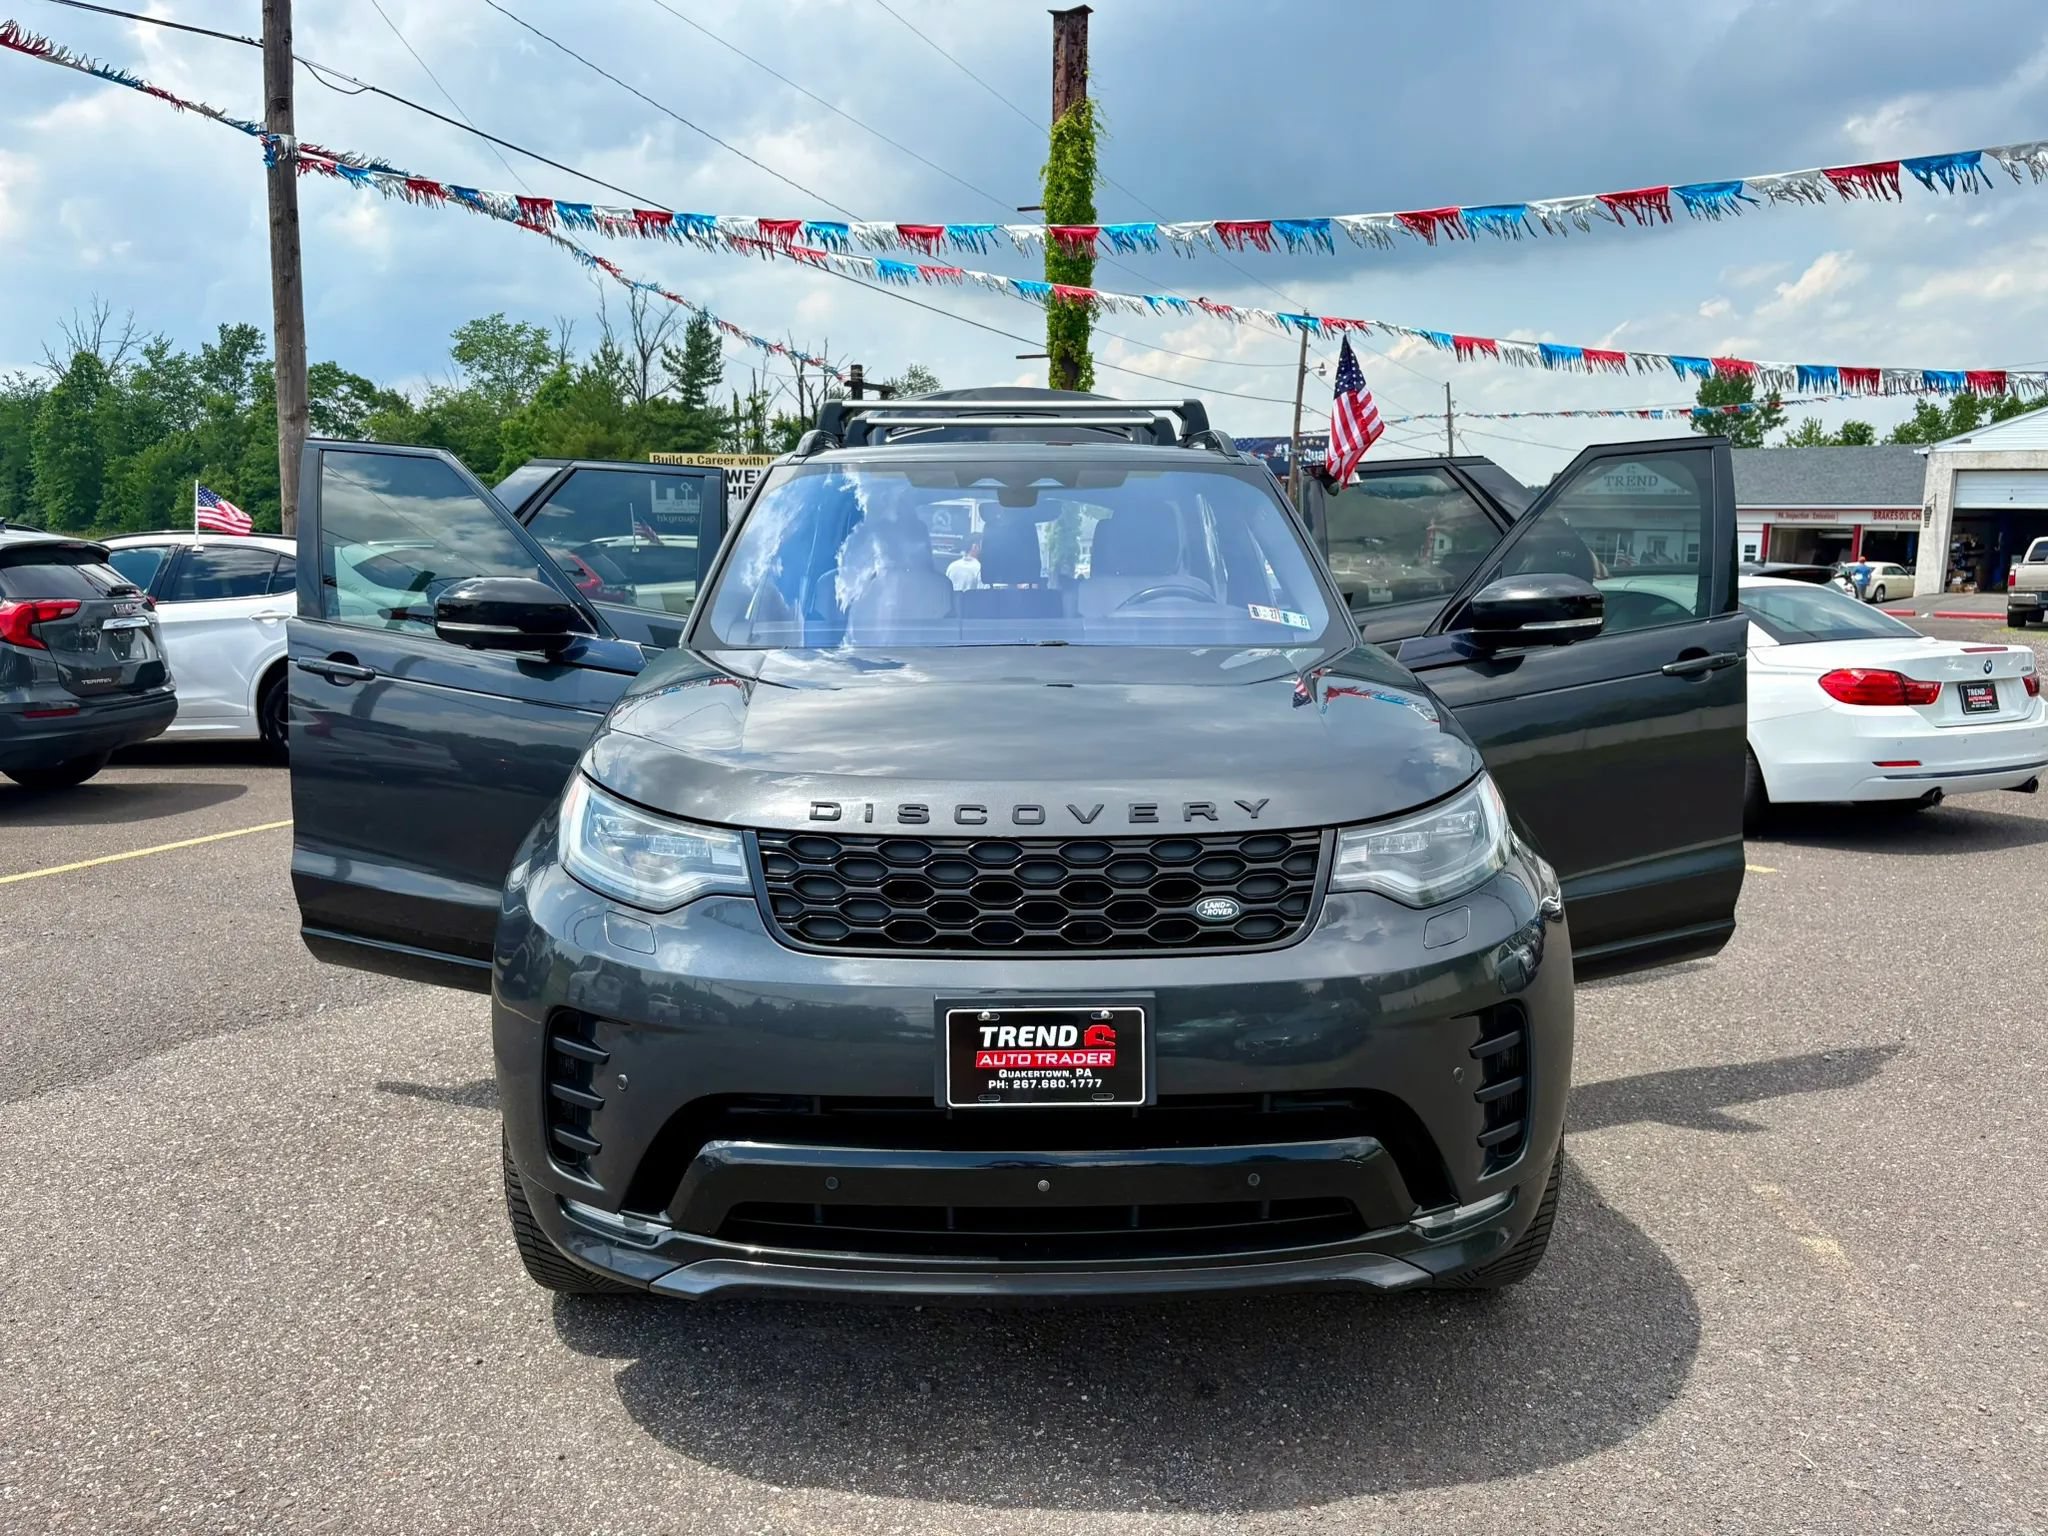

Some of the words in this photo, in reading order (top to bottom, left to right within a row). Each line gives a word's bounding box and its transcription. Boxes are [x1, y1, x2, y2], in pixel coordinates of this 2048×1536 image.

[652, 454, 683, 465] Build
[697, 455, 734, 466] Career
[738, 456, 764, 466] with
[1604, 475, 1659, 487] TREND
[1873, 511, 1898, 520] BRAKES
[1967, 688, 1985, 696] TREND
[809, 798, 1270, 825] DISCOVERY
[1207, 908, 1233, 916] ROVER
[979, 1025, 1078, 1048] TREND
[979, 1054, 1031, 1066] AUTO
[1034, 1052, 1111, 1065] TRADER
[1076, 1068, 1092, 1077] PA
[988, 1079, 1009, 1089] PH:
[1013, 1079, 1103, 1089] 267.680.1777
